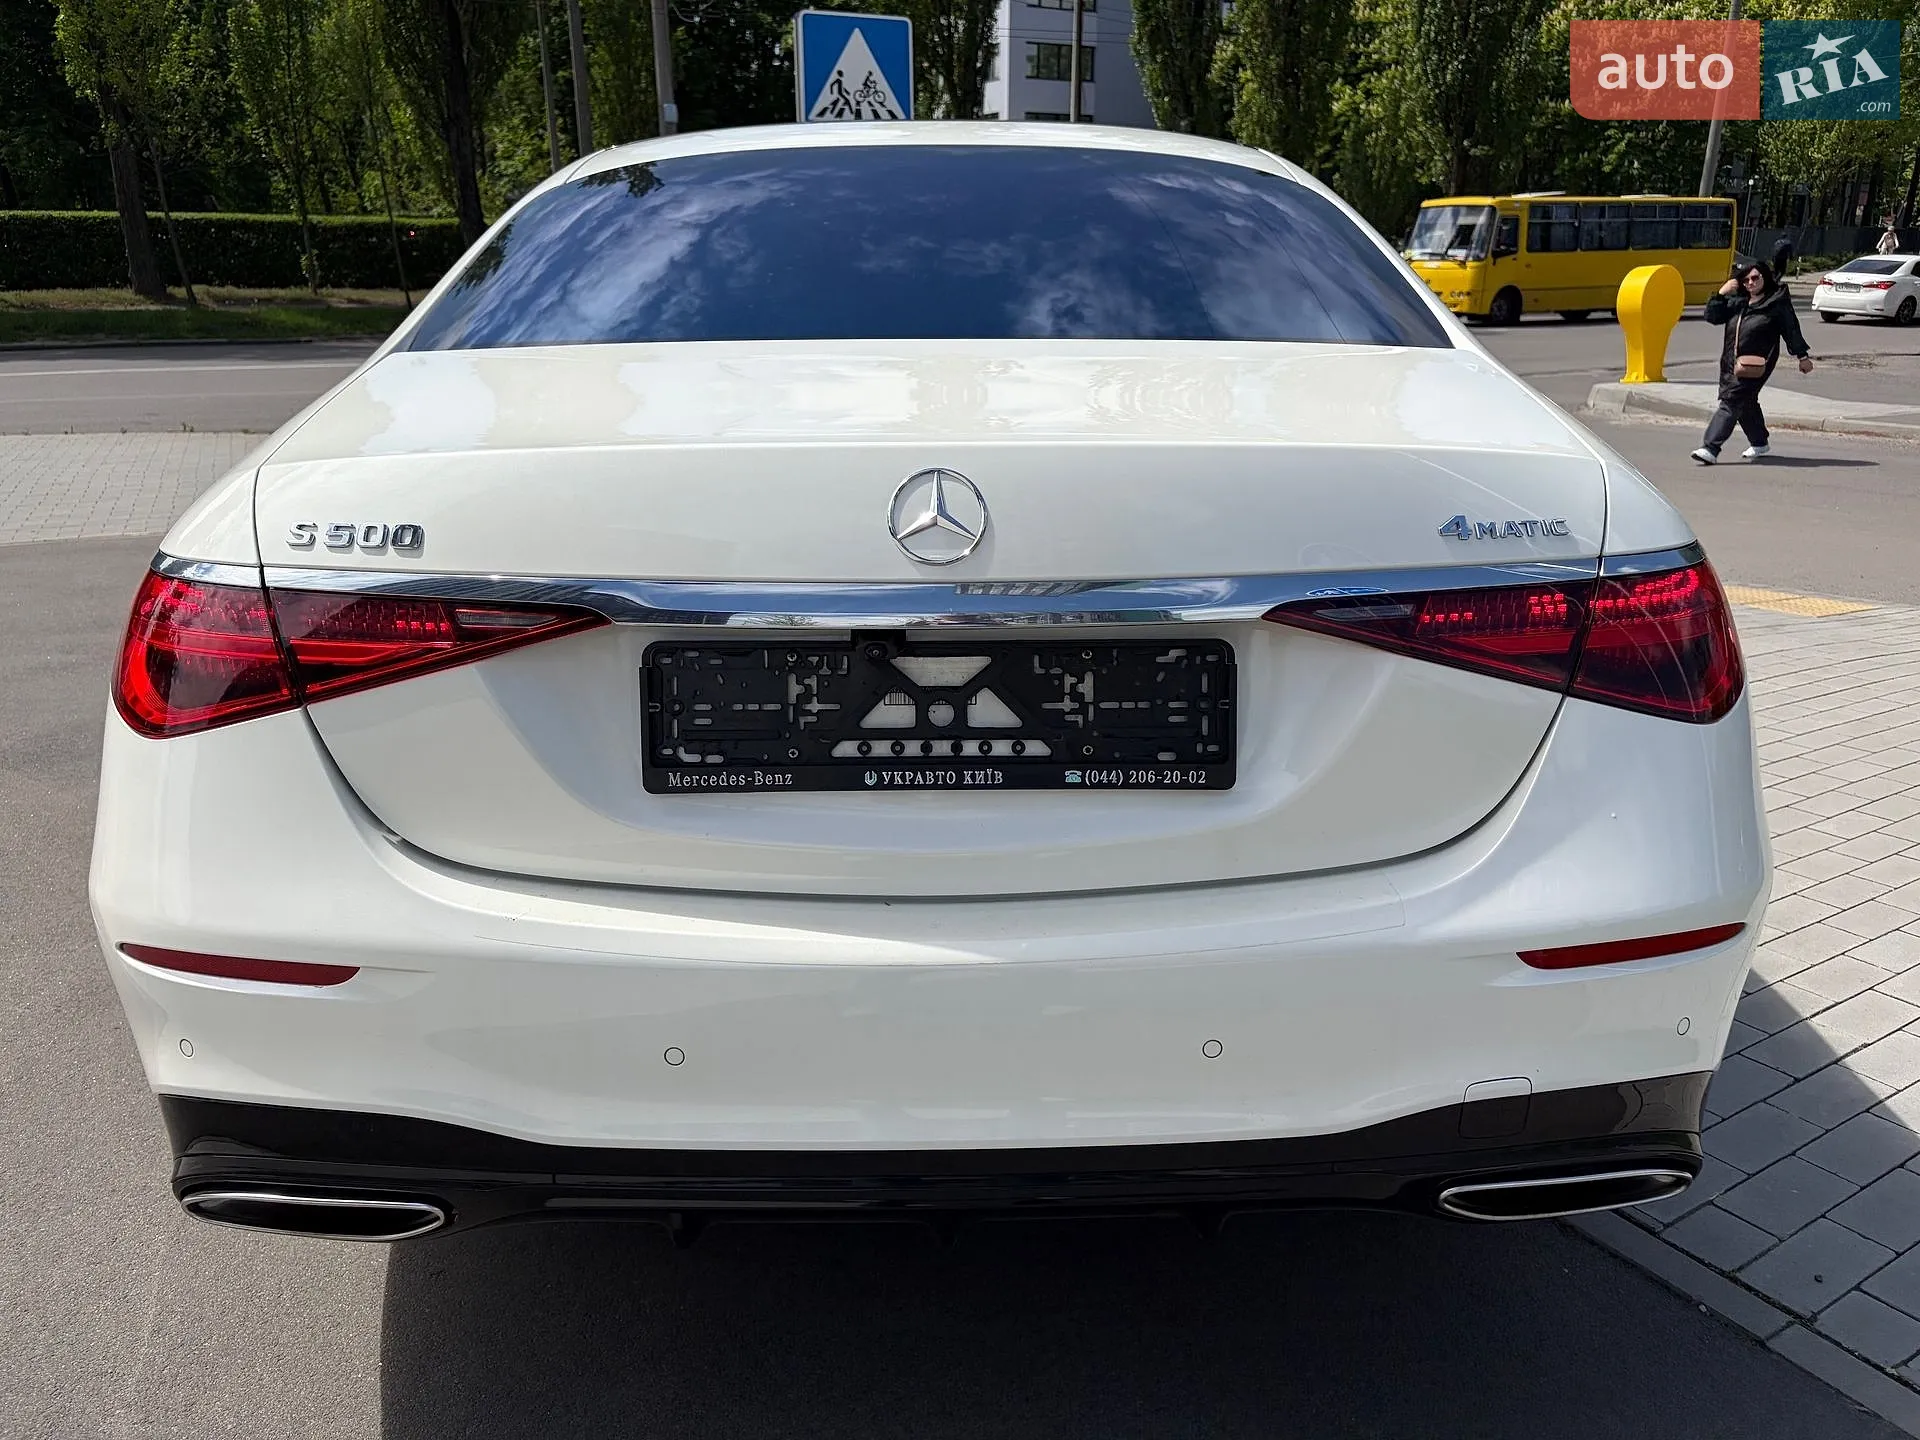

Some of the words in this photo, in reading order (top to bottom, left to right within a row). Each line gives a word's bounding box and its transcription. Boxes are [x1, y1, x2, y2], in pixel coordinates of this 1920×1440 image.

[286, 521, 319, 547] S
[323, 521, 425, 551] 500
[1439, 513, 1571, 541] 4MATIC
[667, 770, 793, 788] Mercedes-Benz
[881, 770, 957, 785] УКРАВТО
[962, 768, 1004, 785] КИЇВ
[1084, 769, 1124, 786] (044)
[1128, 769, 1207, 785] 206-20-02
